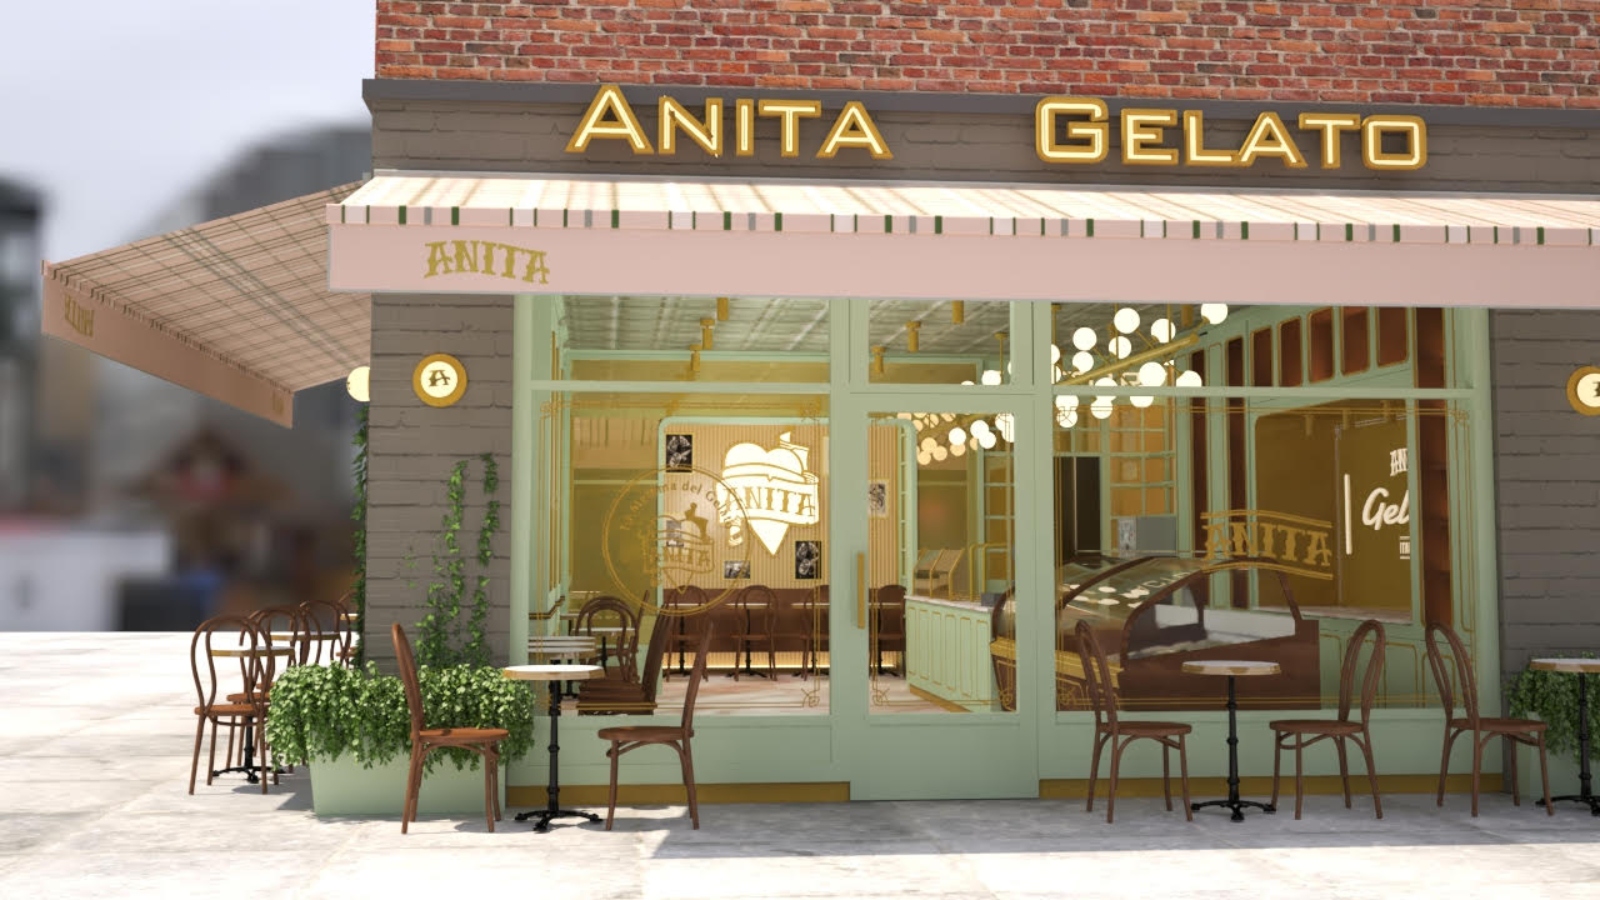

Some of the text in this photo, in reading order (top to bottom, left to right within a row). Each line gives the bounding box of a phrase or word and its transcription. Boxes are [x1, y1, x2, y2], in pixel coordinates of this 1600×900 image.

[1036, 96, 1426, 171] GELATO
[424, 239, 551, 286] ANITA
[428, 369, 451, 387] A
[1202, 522, 1333, 567] ANITA
